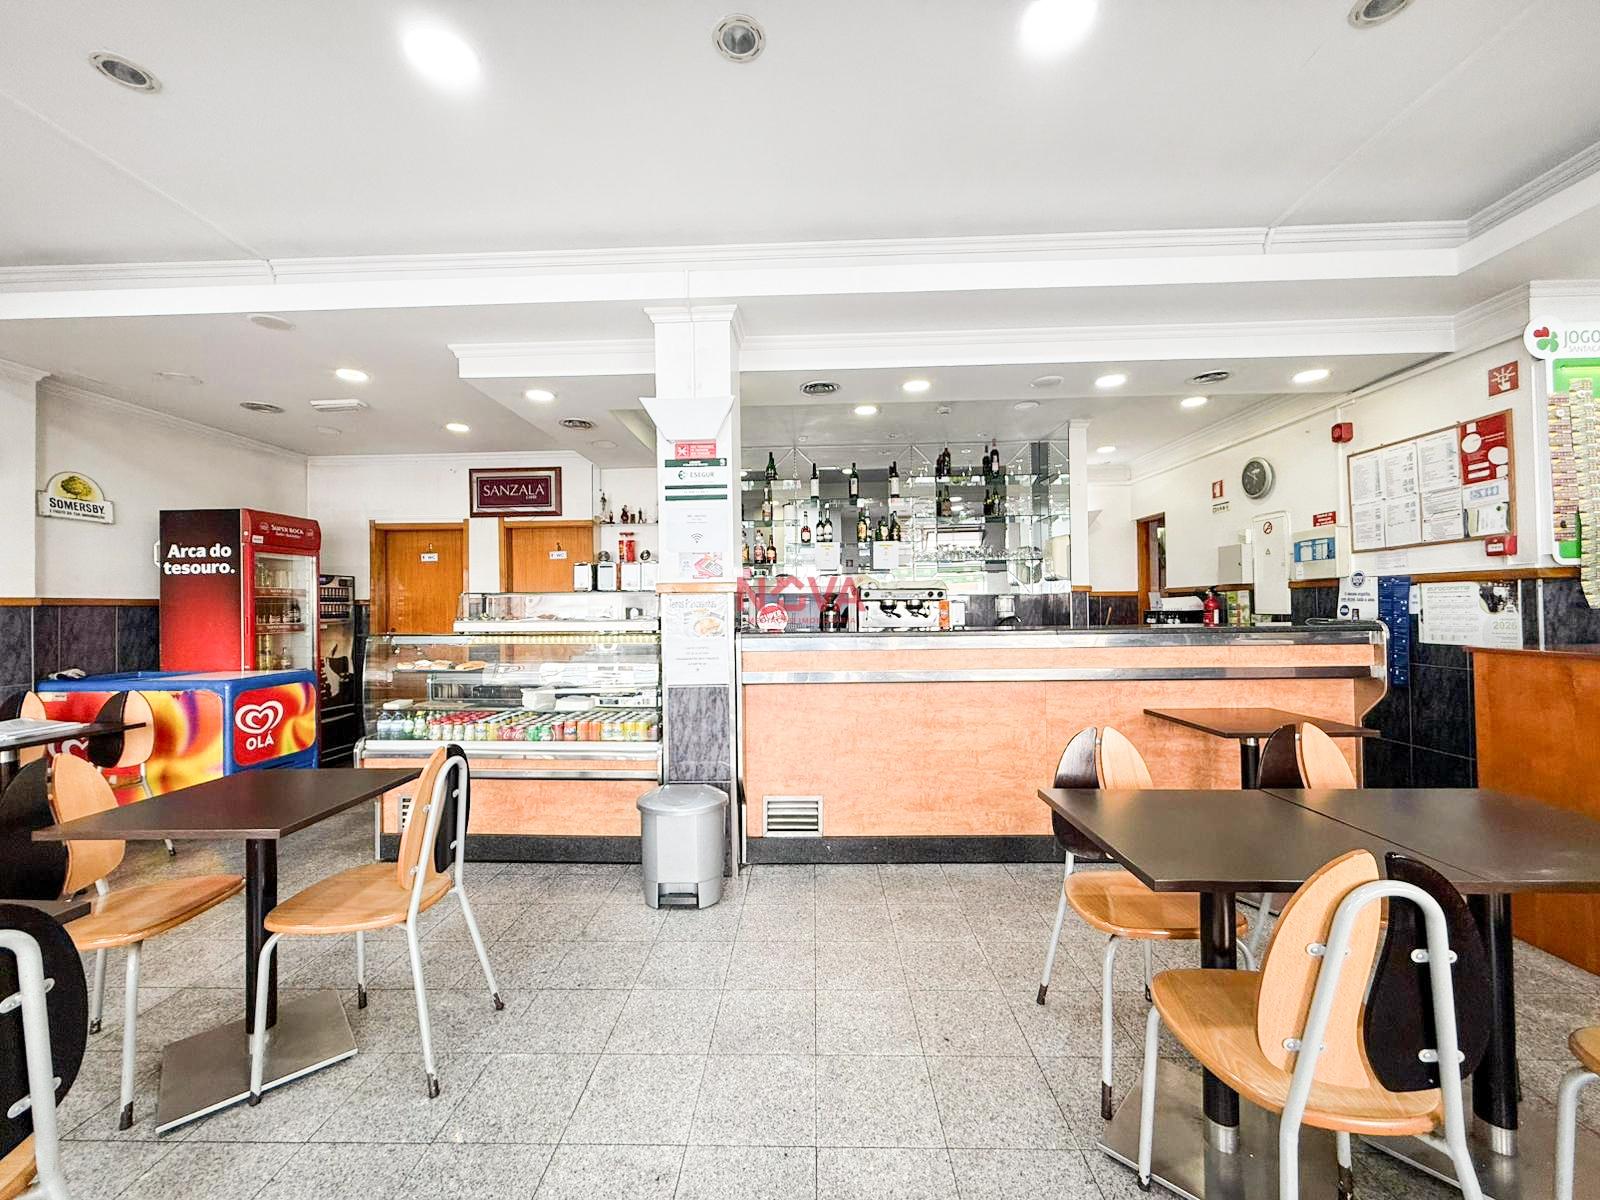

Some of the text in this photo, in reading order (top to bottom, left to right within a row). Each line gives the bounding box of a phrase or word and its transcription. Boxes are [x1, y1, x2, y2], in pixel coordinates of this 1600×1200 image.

[483, 483, 545, 497] SANZALA
[49, 497, 105, 515] SOMERSBY
[167, 542, 232, 559] Arca do
[163, 561, 236, 575] tesouro.
[245, 730, 274, 751] OLÁ
